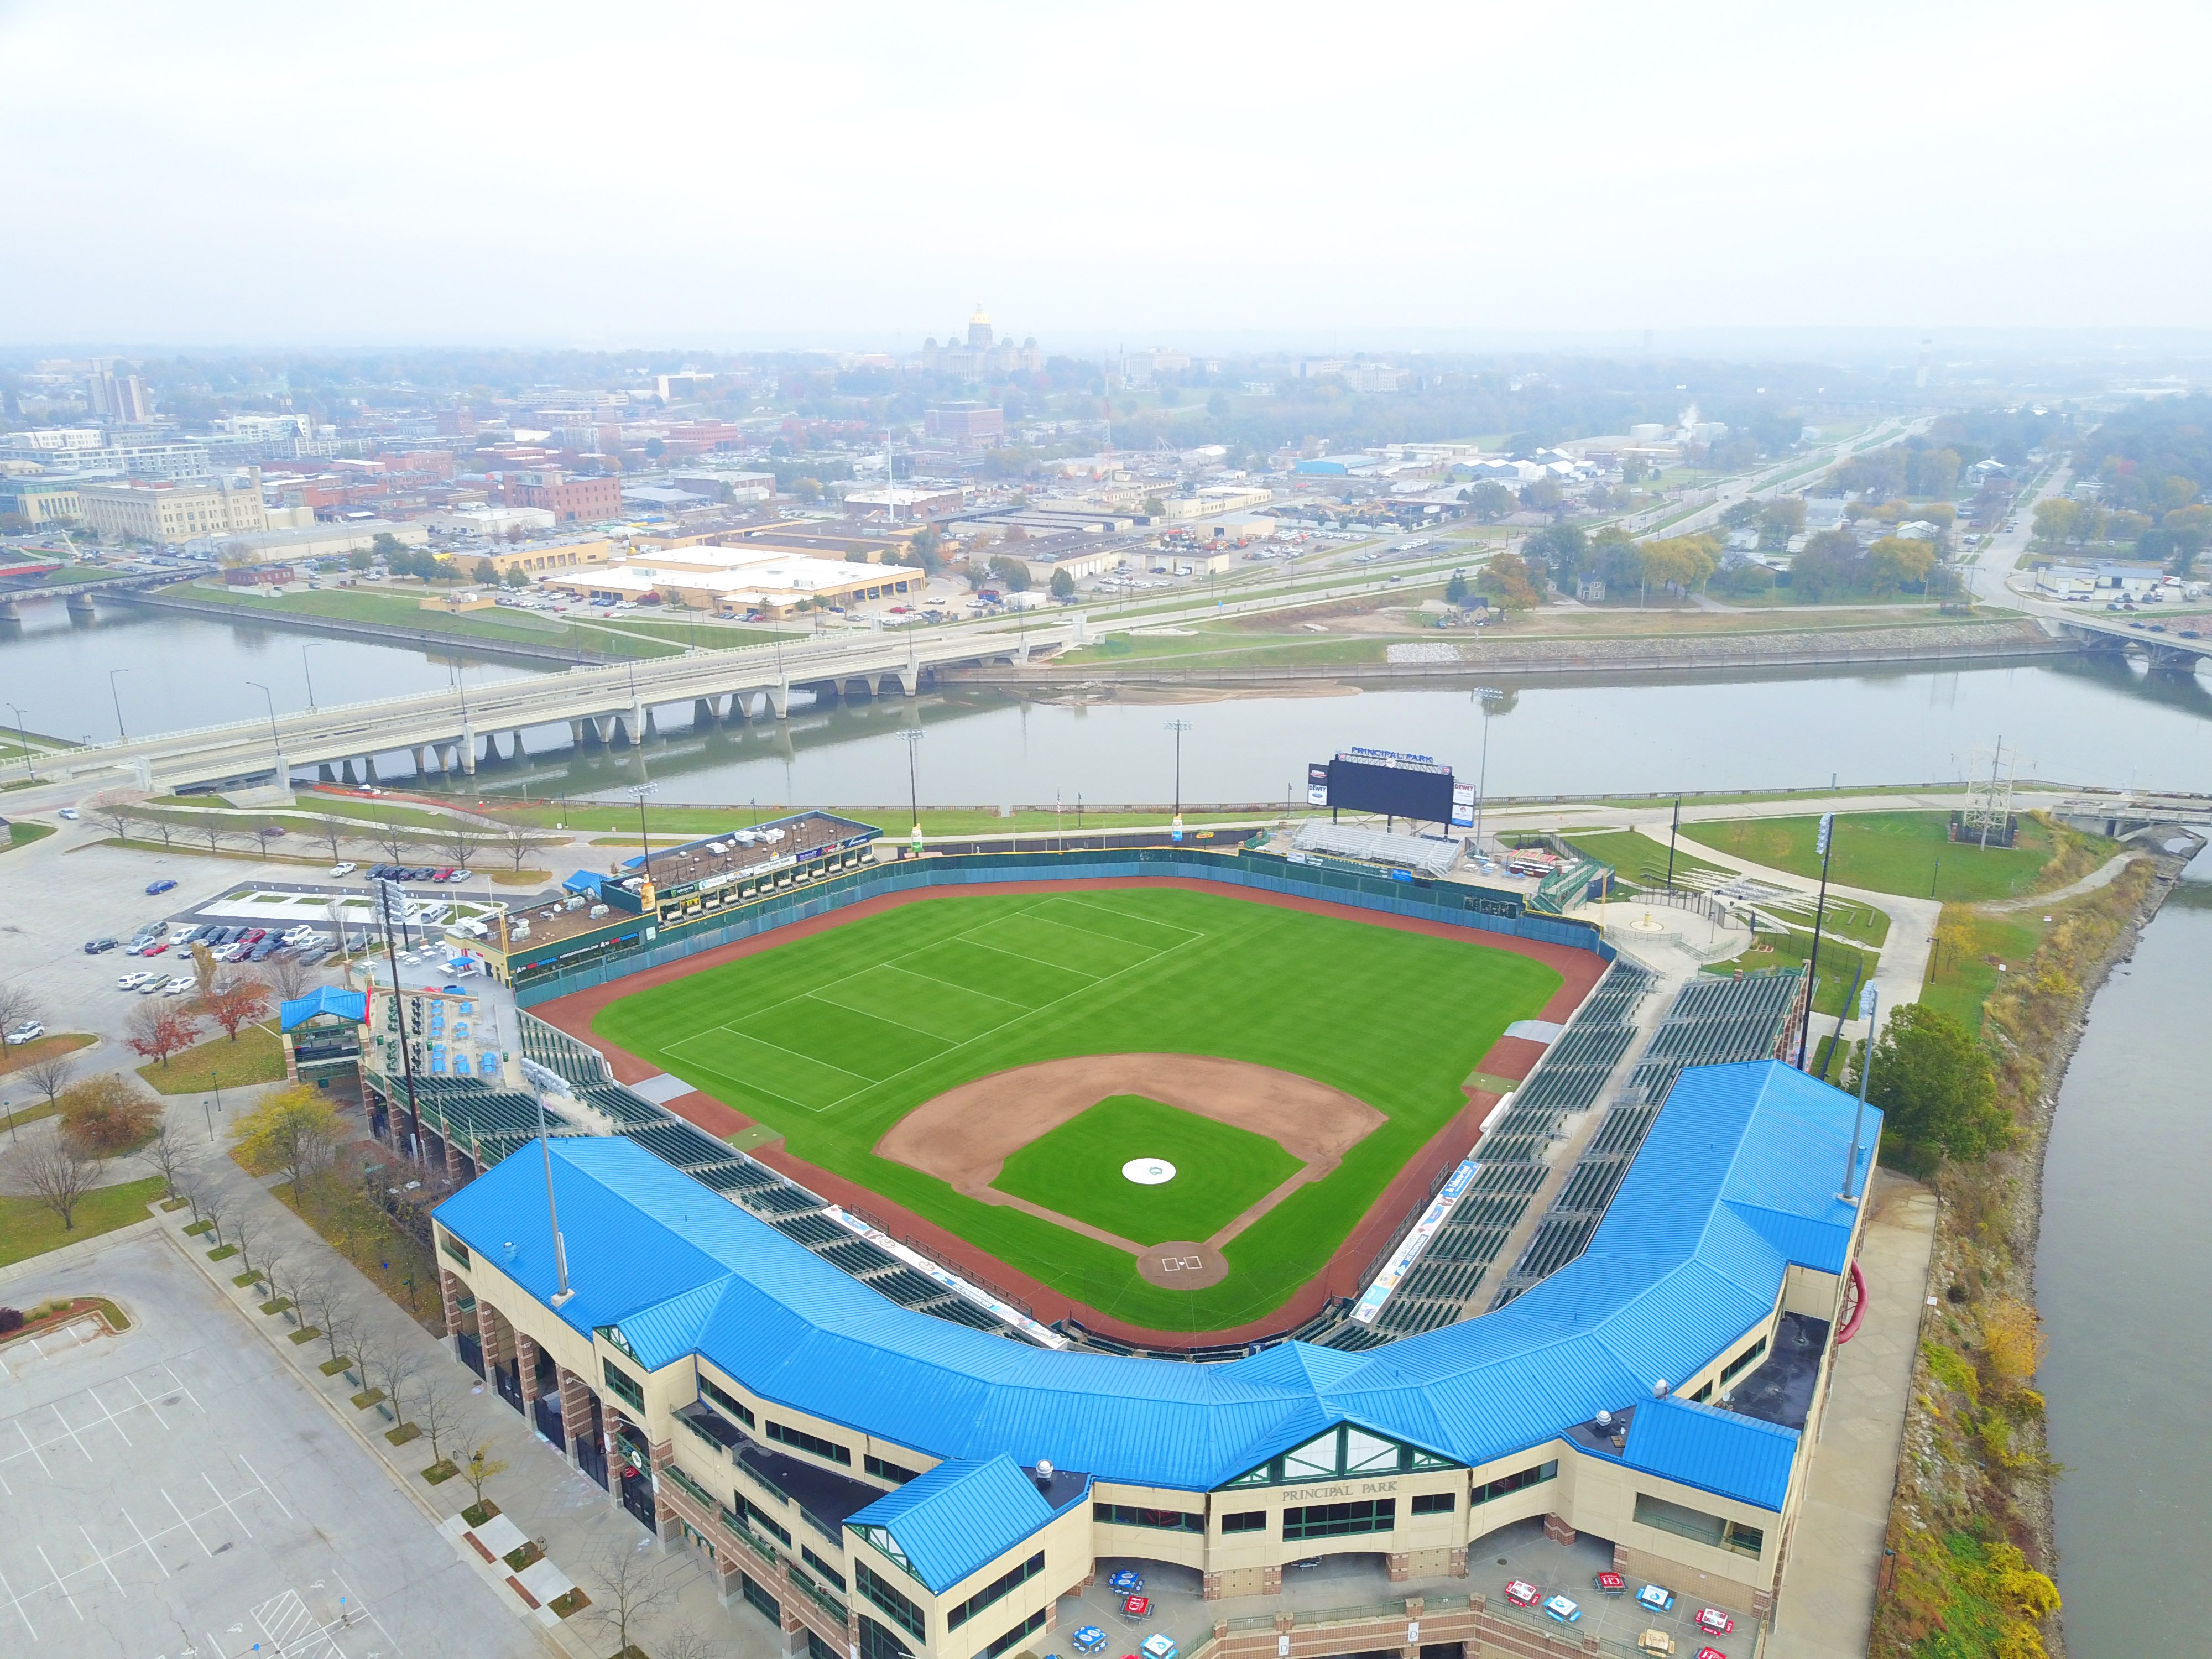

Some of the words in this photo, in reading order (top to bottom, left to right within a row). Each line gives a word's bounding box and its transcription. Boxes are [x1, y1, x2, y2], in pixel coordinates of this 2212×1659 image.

[1351, 746, 1402, 759] PRINCIPAL
[1405, 753, 1433, 763] PARK
[610, 932, 638, 944] GEOTHERMAL
[526, 957, 557, 969] GEOTHERMAL
[1282, 1485, 1354, 1501] PRINCIPAL
[1362, 1480, 1398, 1494] PARK
[1129, 1597, 1142, 1610] CH
